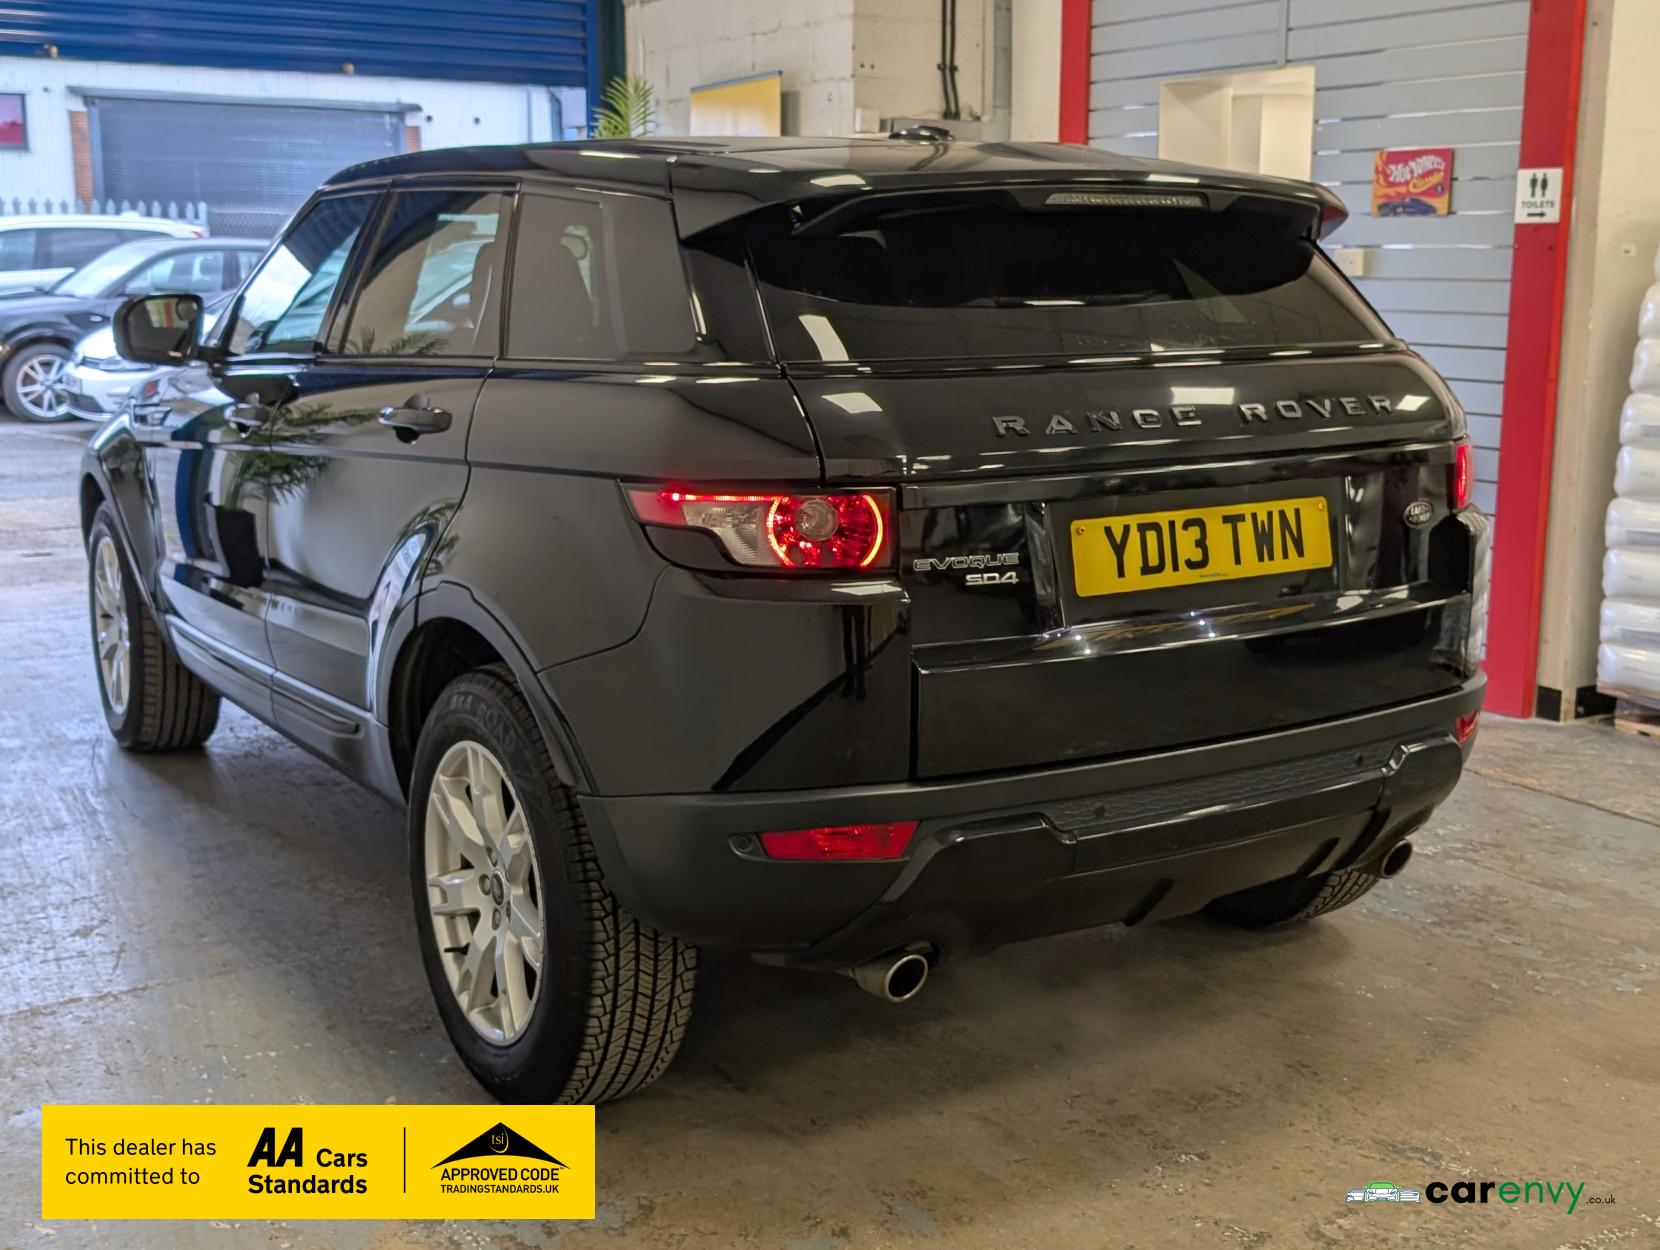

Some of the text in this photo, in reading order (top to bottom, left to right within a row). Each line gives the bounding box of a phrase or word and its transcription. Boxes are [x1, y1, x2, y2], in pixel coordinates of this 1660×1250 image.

[1521, 200, 1555, 209] TOILETS
[992, 395, 1393, 437] RANGE ROVER
[1104, 507, 1305, 579] YD13 TWN
[913, 552, 1019, 571] EVOQUE
[965, 571, 1019, 586] SD4
